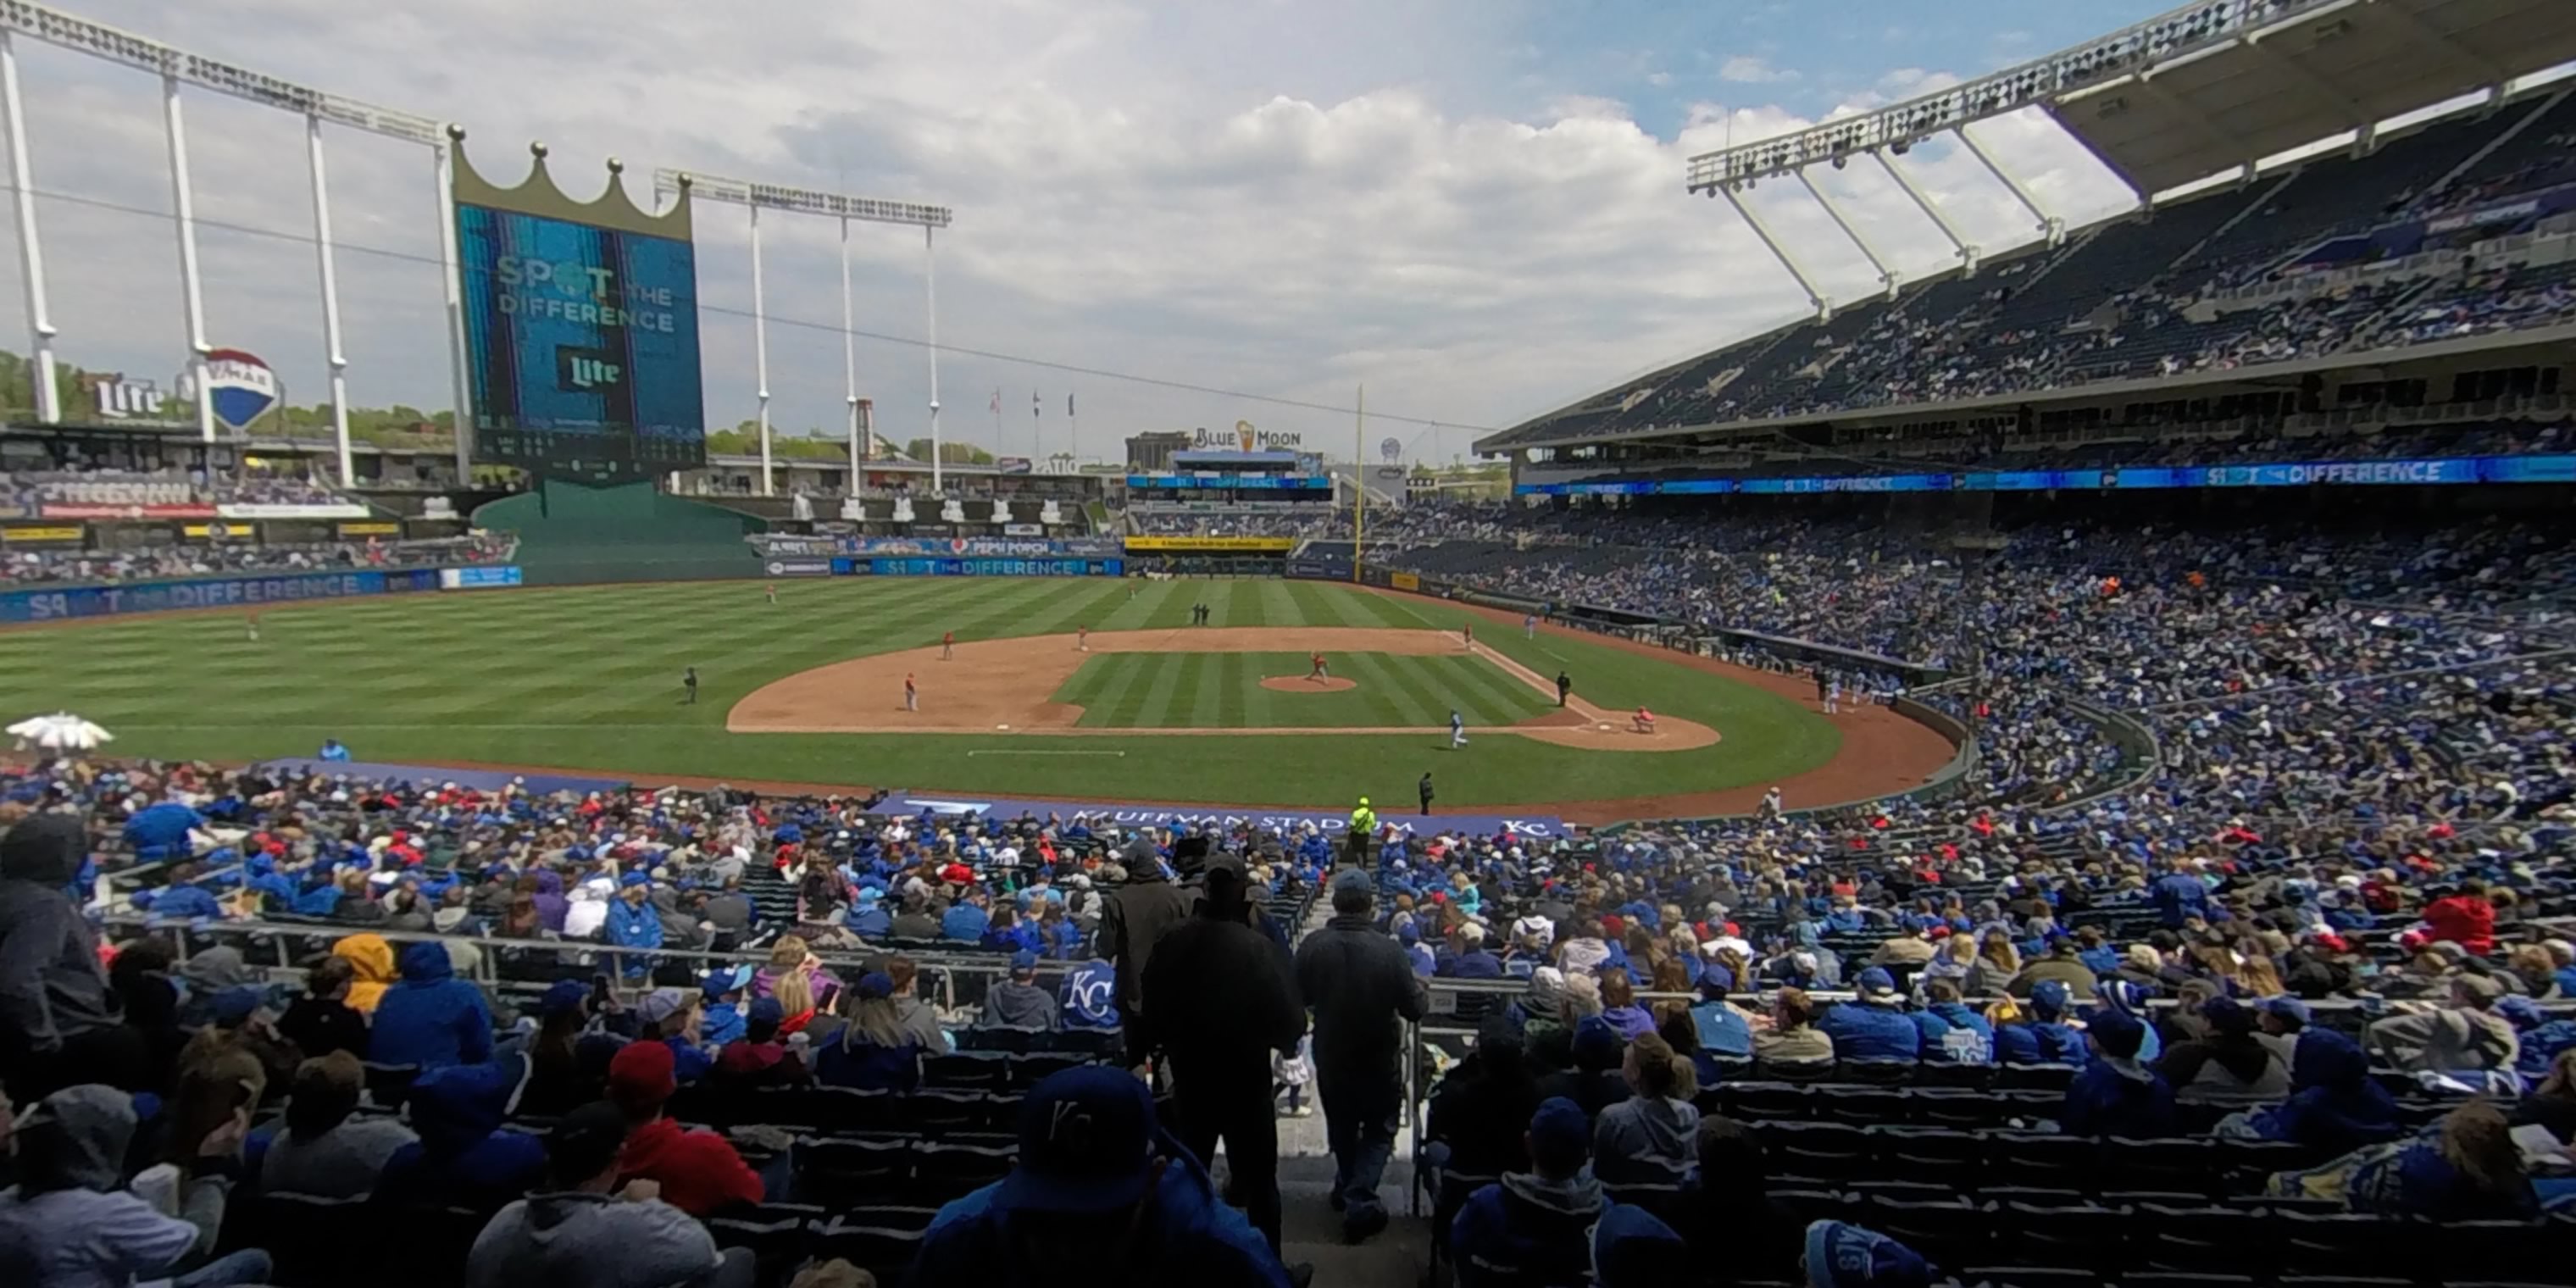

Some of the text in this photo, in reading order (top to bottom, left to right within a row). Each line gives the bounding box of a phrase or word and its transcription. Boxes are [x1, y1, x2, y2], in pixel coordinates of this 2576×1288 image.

[625, 282, 673, 306] THE
[497, 295, 675, 333] DIFFERENCE
[570, 357, 620, 387] Lite
[95, 381, 165, 419] Lite
[1194, 428, 1301, 448] BLUE MOON
[1031, 458, 1080, 475] PATIO
[2288, 462, 2446, 484] DIFFERENCE
[962, 560, 1074, 575] DIFFERENCE
[172, 575, 360, 608] DIFFERENCE
[1260, 816, 1414, 834] STADM
[1501, 820, 1550, 836] KC
[1064, 970, 1112, 1018] KC
